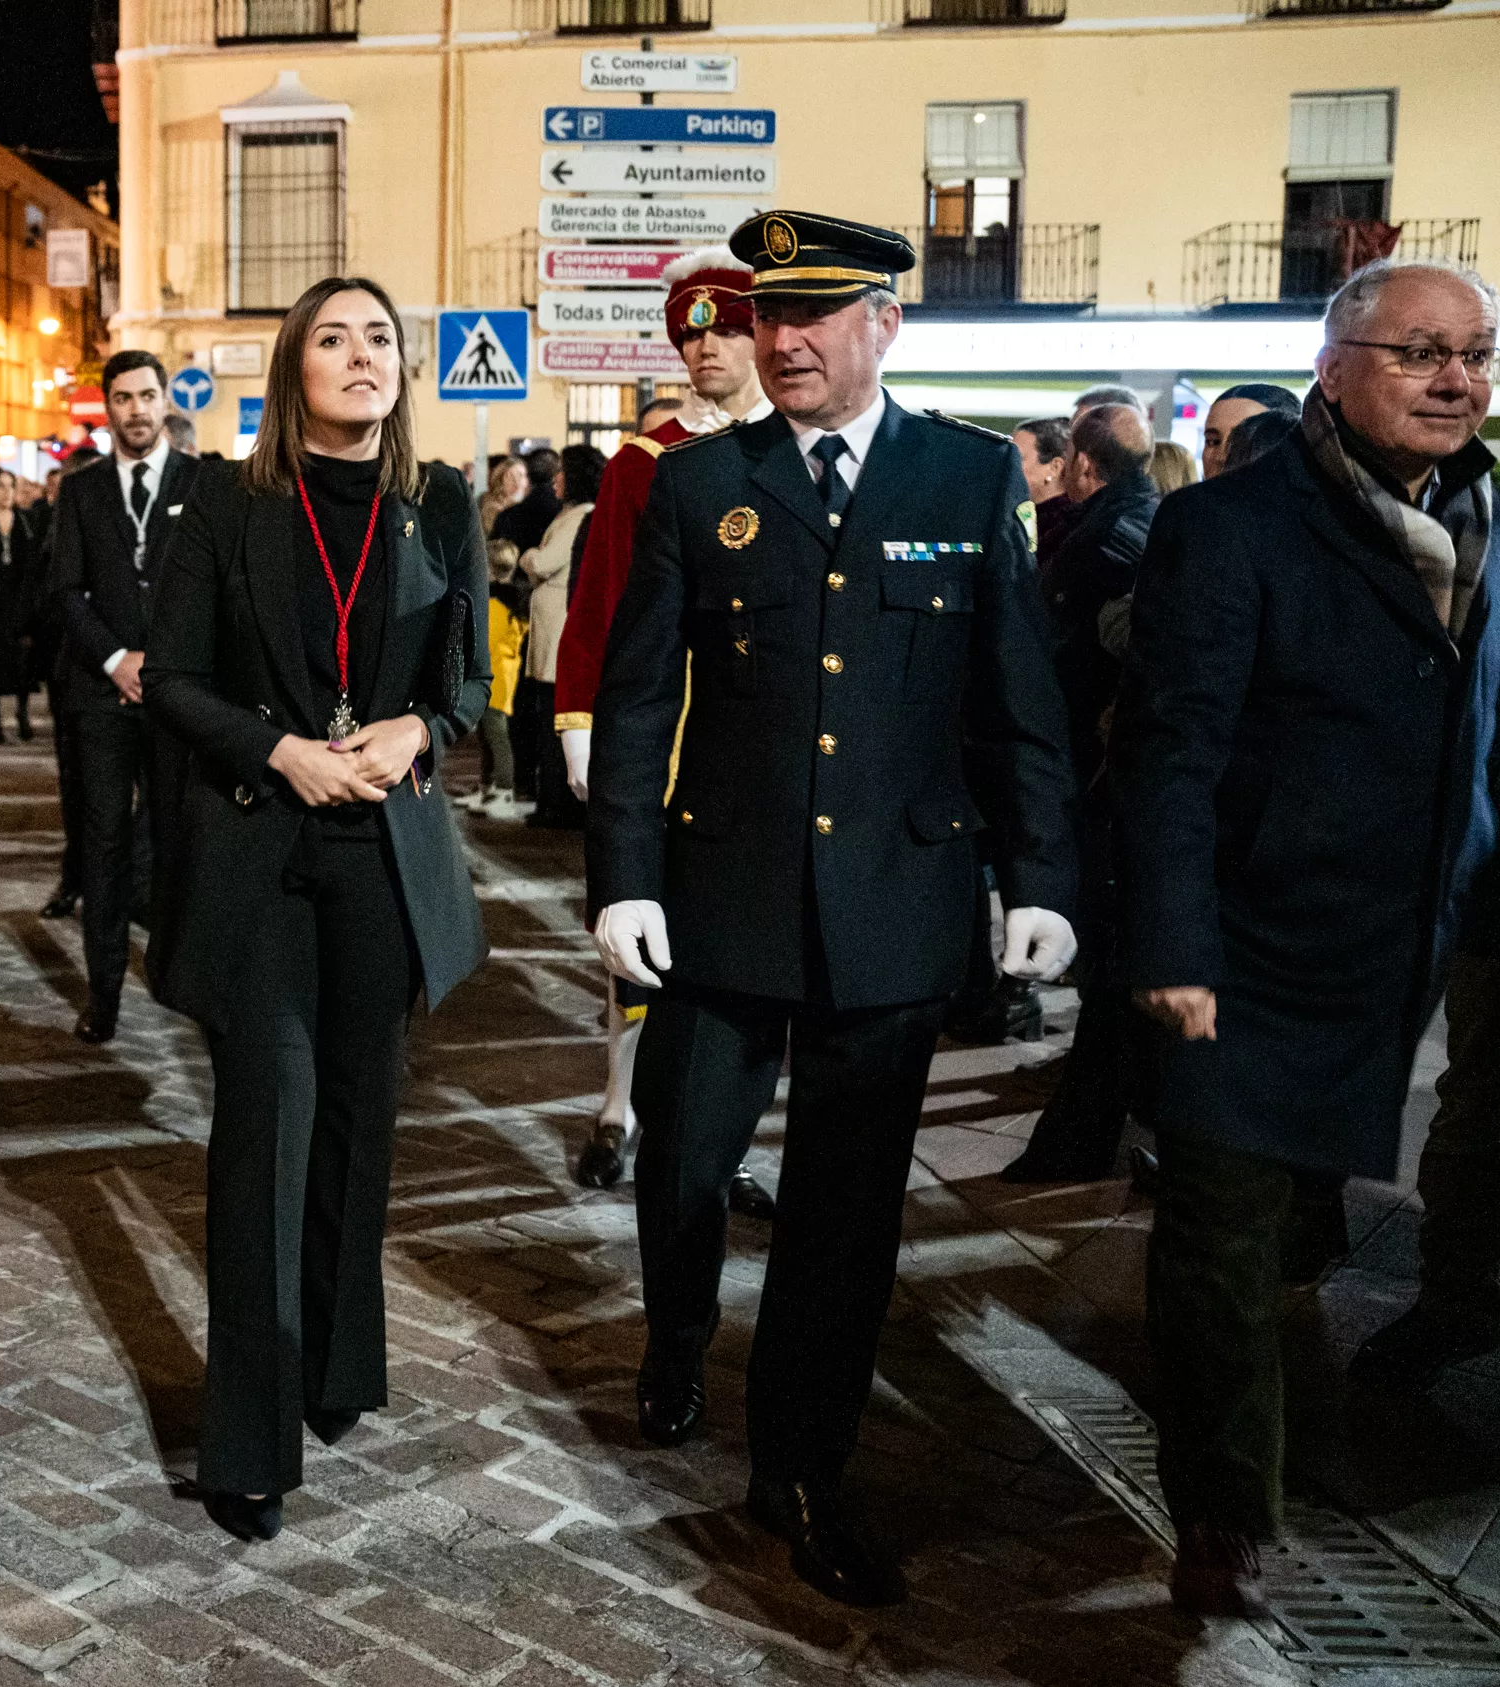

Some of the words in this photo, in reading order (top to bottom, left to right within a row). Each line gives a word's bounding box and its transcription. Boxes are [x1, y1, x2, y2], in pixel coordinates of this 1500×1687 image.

[590, 56, 604, 69] C.
[611, 56, 687, 70] Comercial
[590, 73, 645, 87] Abierto
[582, 115, 600, 134] P
[686, 114, 766, 139] Parking
[624, 163, 765, 186] Ayuntamiento
[551, 204, 617, 218] Mercado
[622, 204, 640, 218] de
[645, 204, 706, 218] Abastos
[551, 219, 617, 233] Gerencia
[622, 220, 640, 233] de
[646, 220, 727, 235] Urbanismo
[553, 251, 658, 265] Conservatorio
[553, 266, 628, 279] Biblioteca
[553, 303, 604, 321] Todas
[611, 303, 666, 321] Direcc
[548, 342, 604, 356] Castillo
[609, 343, 632, 356] del
[637, 343, 679, 357] Mora
[548, 355, 599, 367] Museo
